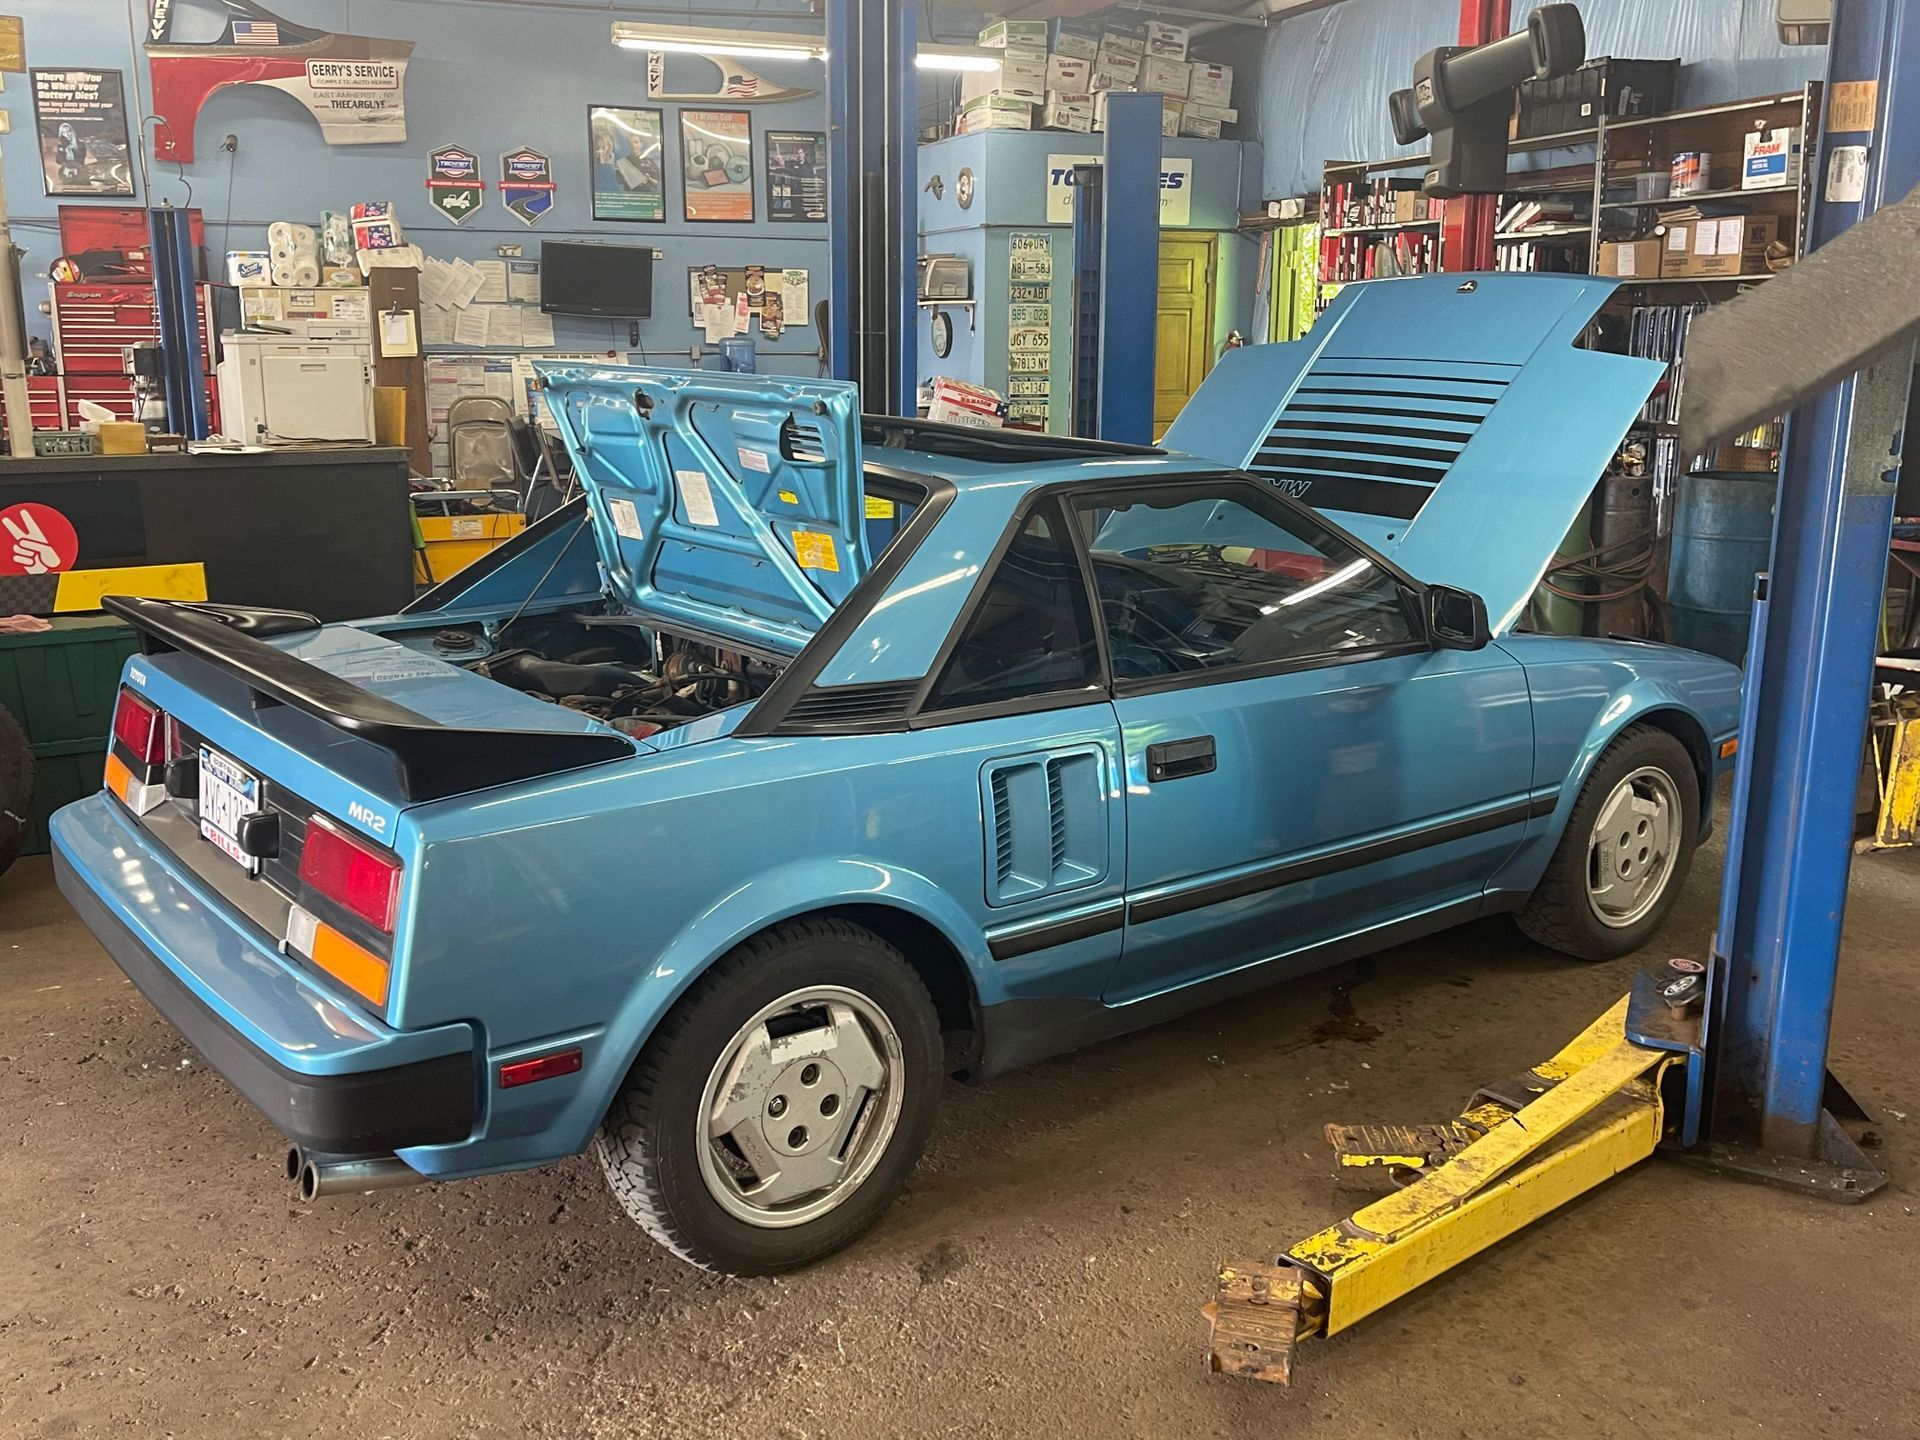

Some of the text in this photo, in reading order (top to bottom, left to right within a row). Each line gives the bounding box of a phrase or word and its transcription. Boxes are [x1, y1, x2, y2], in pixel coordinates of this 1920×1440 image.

[312, 64, 395, 78] GERRY'S SERVICE
[36, 72, 65, 81] Where
[37, 82, 99, 91] Be When Your
[38, 91, 99, 100] Battery Dies?
[1753, 143, 1781, 155] FRAM
[66, 291, 102, 300] Snap-on
[348, 801, 386, 834] MR2
[209, 830, 240, 861] BILLS
